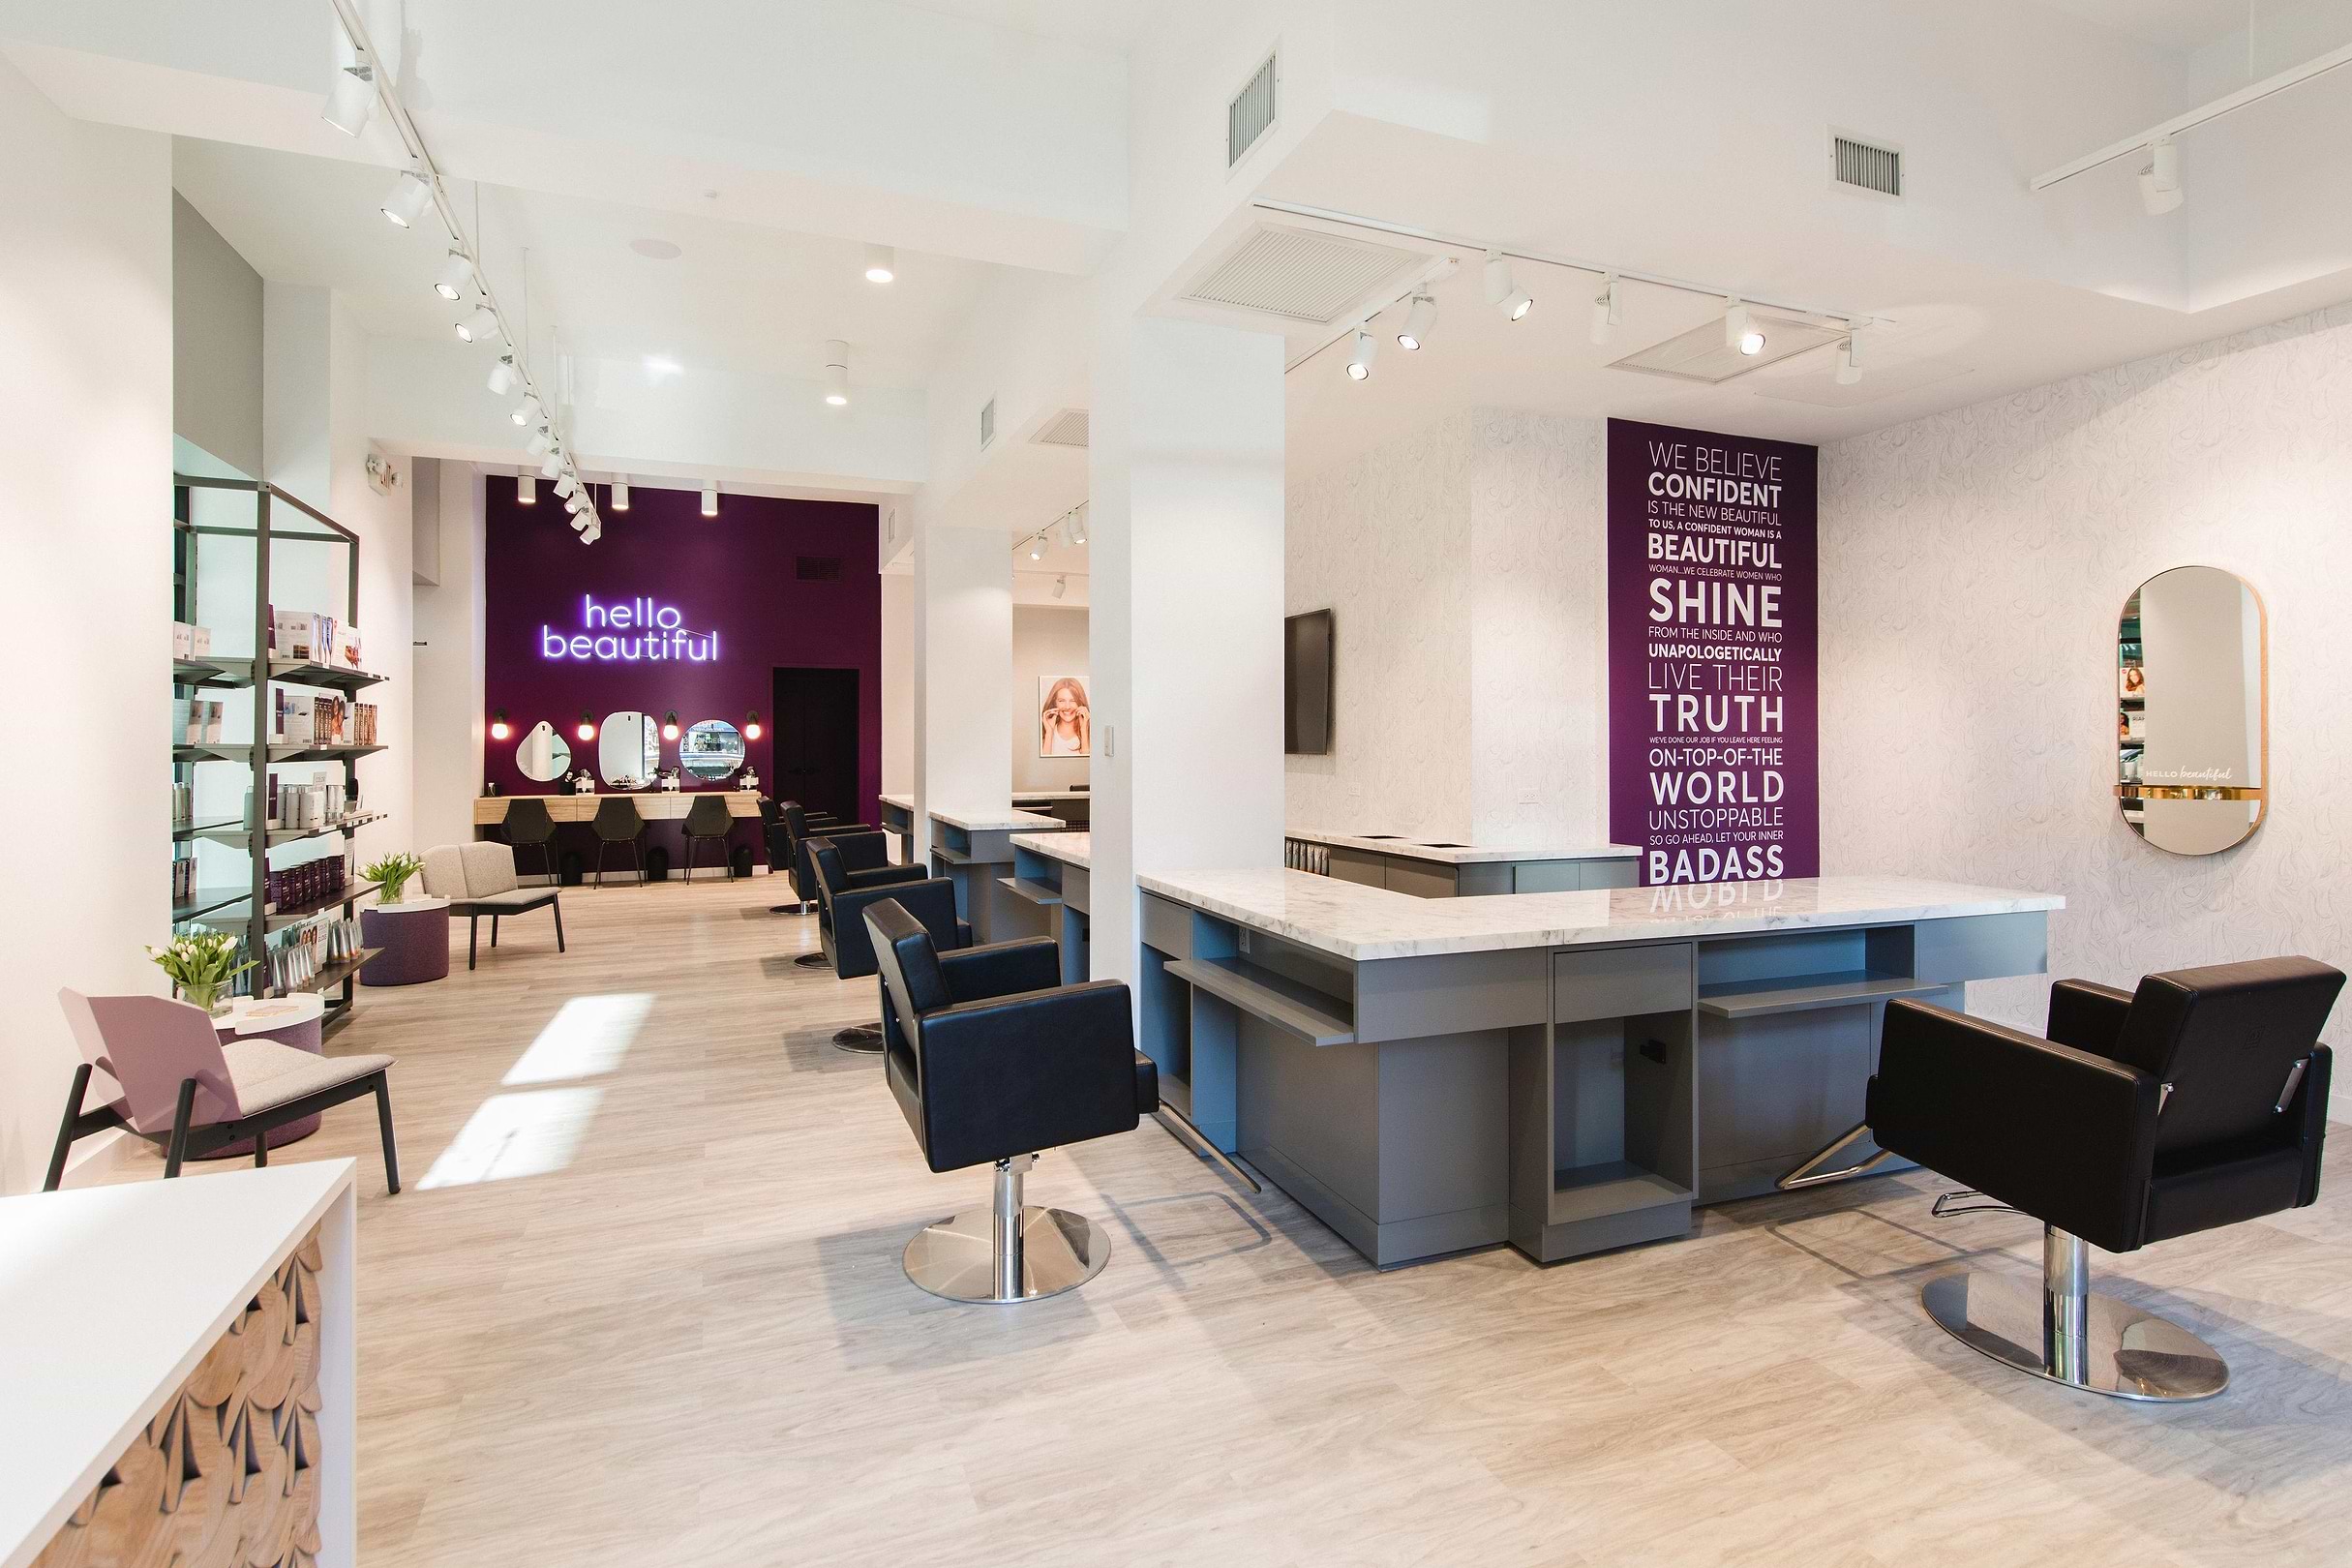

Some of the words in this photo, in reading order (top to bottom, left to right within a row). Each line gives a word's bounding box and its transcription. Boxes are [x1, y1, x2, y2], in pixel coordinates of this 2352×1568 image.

[1648, 440, 1687, 469] WE
[1696, 447, 1782, 482] BELIEVE
[1648, 471, 1782, 508] CONFIDENT
[1647, 499, 1659, 514] IS
[1662, 501, 1685, 517] THE
[1689, 505, 1717, 520] NEW
[1721, 508, 1782, 527] BEAUTIFUL
[1648, 518, 1660, 528] TO
[1663, 520, 1675, 530] US,
[1677, 521, 1683, 530] A
[1685, 522, 1732, 534] CONFIDENT
[1734, 527, 1765, 538] WOMAN
[1767, 529, 1774, 539] IS
[1648, 532, 1782, 568] BEAUTIFUL
[1697, 567, 1734, 578] CELEBRATE
[1736, 571, 1764, 580] WOMEN
[586, 593, 680, 628] hello
[1648, 577, 1783, 627] SHINE
[543, 624, 717, 660] beautiful
[1649, 626, 1678, 638] FROM
[1681, 628, 1700, 639] THE
[1703, 629, 1733, 641] INSIDE
[1735, 631, 1756, 642] AND
[1758, 632, 1782, 643] WHO
[1649, 644, 1782, 662] UNAPOLOGETICALLY
[1649, 662, 1703, 690] LIVE
[1712, 664, 1783, 691] THEIR
[1649, 694, 1783, 732] TRUTH
[1649, 748, 1783, 767] ON-TOP-OF-THE
[1649, 770, 1785, 804] WORLD
[2180, 765, 2232, 781] beautiful
[1649, 807, 1783, 829] UNSTOPPABLE
[1649, 835, 1663, 845] SO
[1666, 834, 1679, 845] GO
[1682, 833, 1714, 844] AHEAD,
[1716, 832, 1731, 842] LET
[1733, 831, 1757, 841] YOUR
[1759, 830, 1783, 840] INNER
[1650, 845, 1784, 884] BADASS
